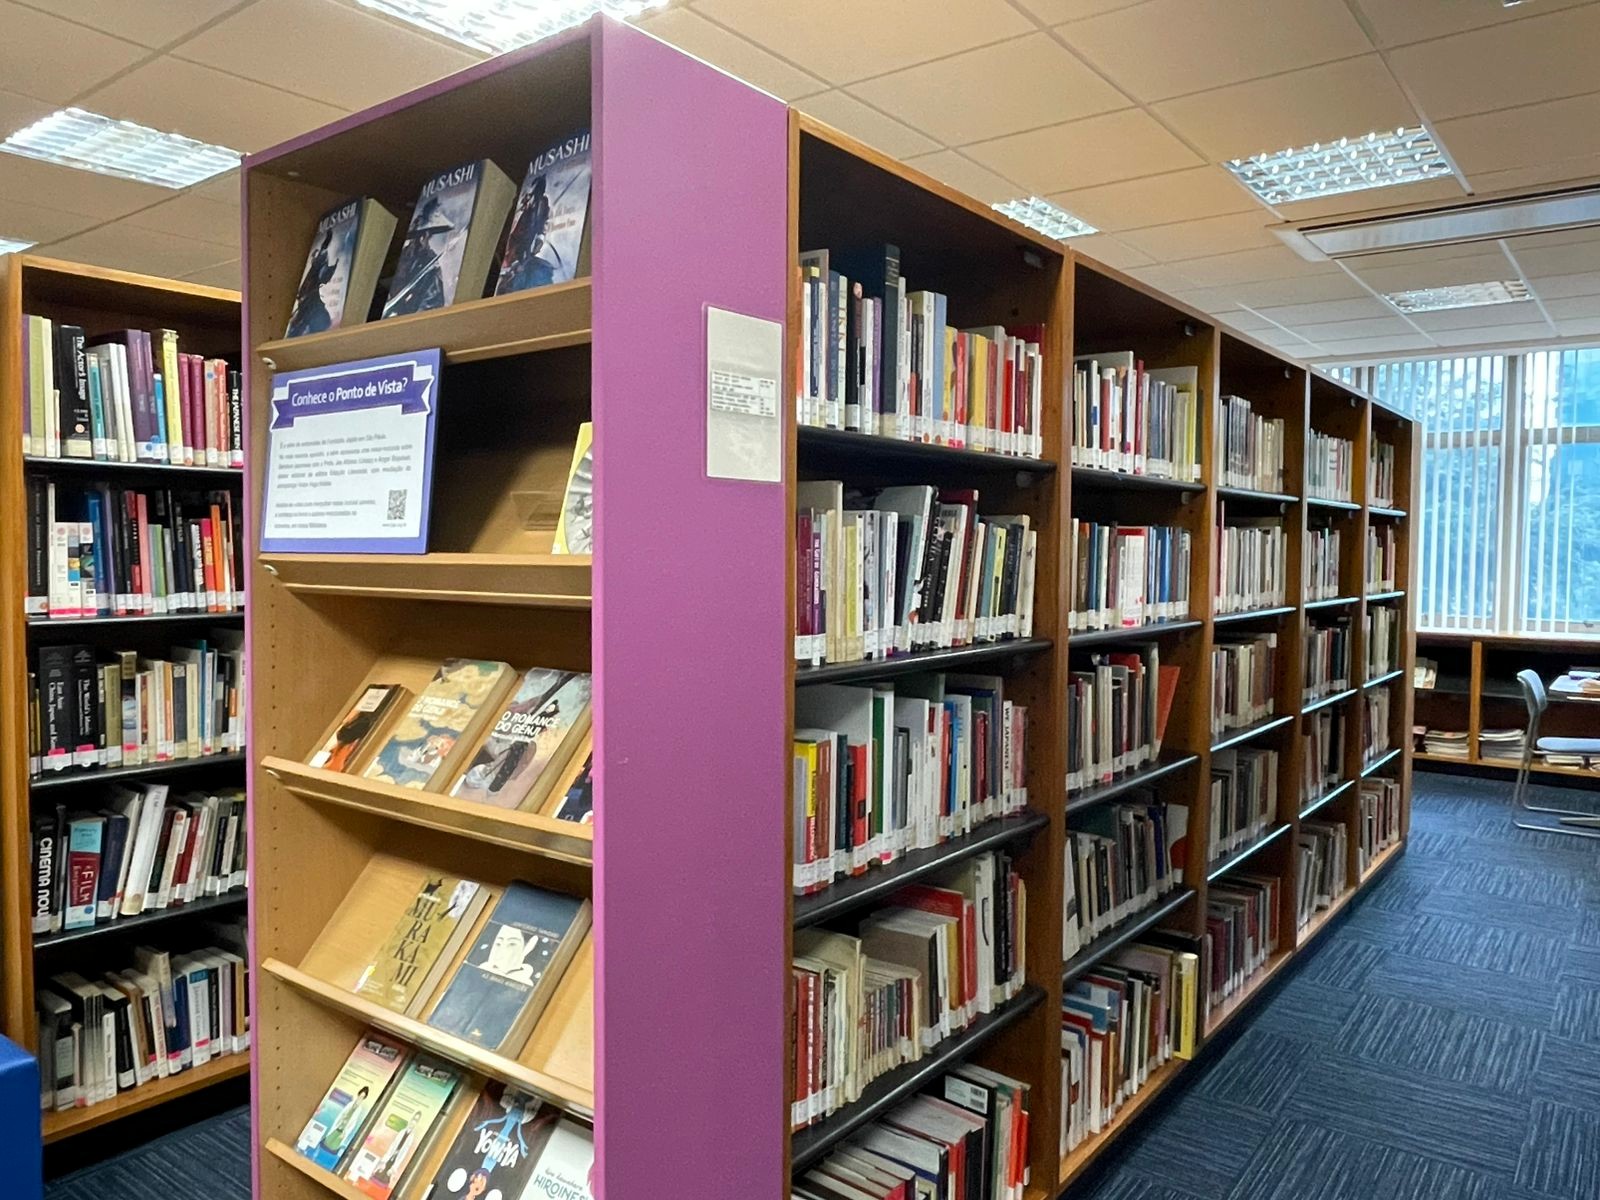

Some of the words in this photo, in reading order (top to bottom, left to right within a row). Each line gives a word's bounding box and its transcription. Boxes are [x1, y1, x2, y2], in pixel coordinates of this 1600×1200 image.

[528, 133, 590, 175] MUSASHI
[421, 163, 475, 197] MUSASHI
[318, 201, 356, 232] MUSASHI
[76, 336, 84, 349] The
[77, 350, 86, 377] Actor's
[78, 378, 86, 400] Image
[291, 390, 327, 407] Conhece
[328, 392, 334, 401] o
[335, 386, 364, 401] Ponto
[364, 382, 377, 397] de
[377, 377, 408, 395] Vista?
[231, 401, 240, 433] JAPANESE
[83, 679, 91, 691] The
[495, 721, 508, 732] DO
[511, 722, 541, 736] GENJI
[502, 711, 511, 721] O
[510, 712, 561, 728] ROMANCE
[37, 837, 53, 886] CINEMA
[79, 870, 94, 902] FILM
[408, 897, 436, 921] MU
[405, 921, 431, 943] RA
[393, 939, 421, 964] KA
[390, 962, 418, 987] MI
